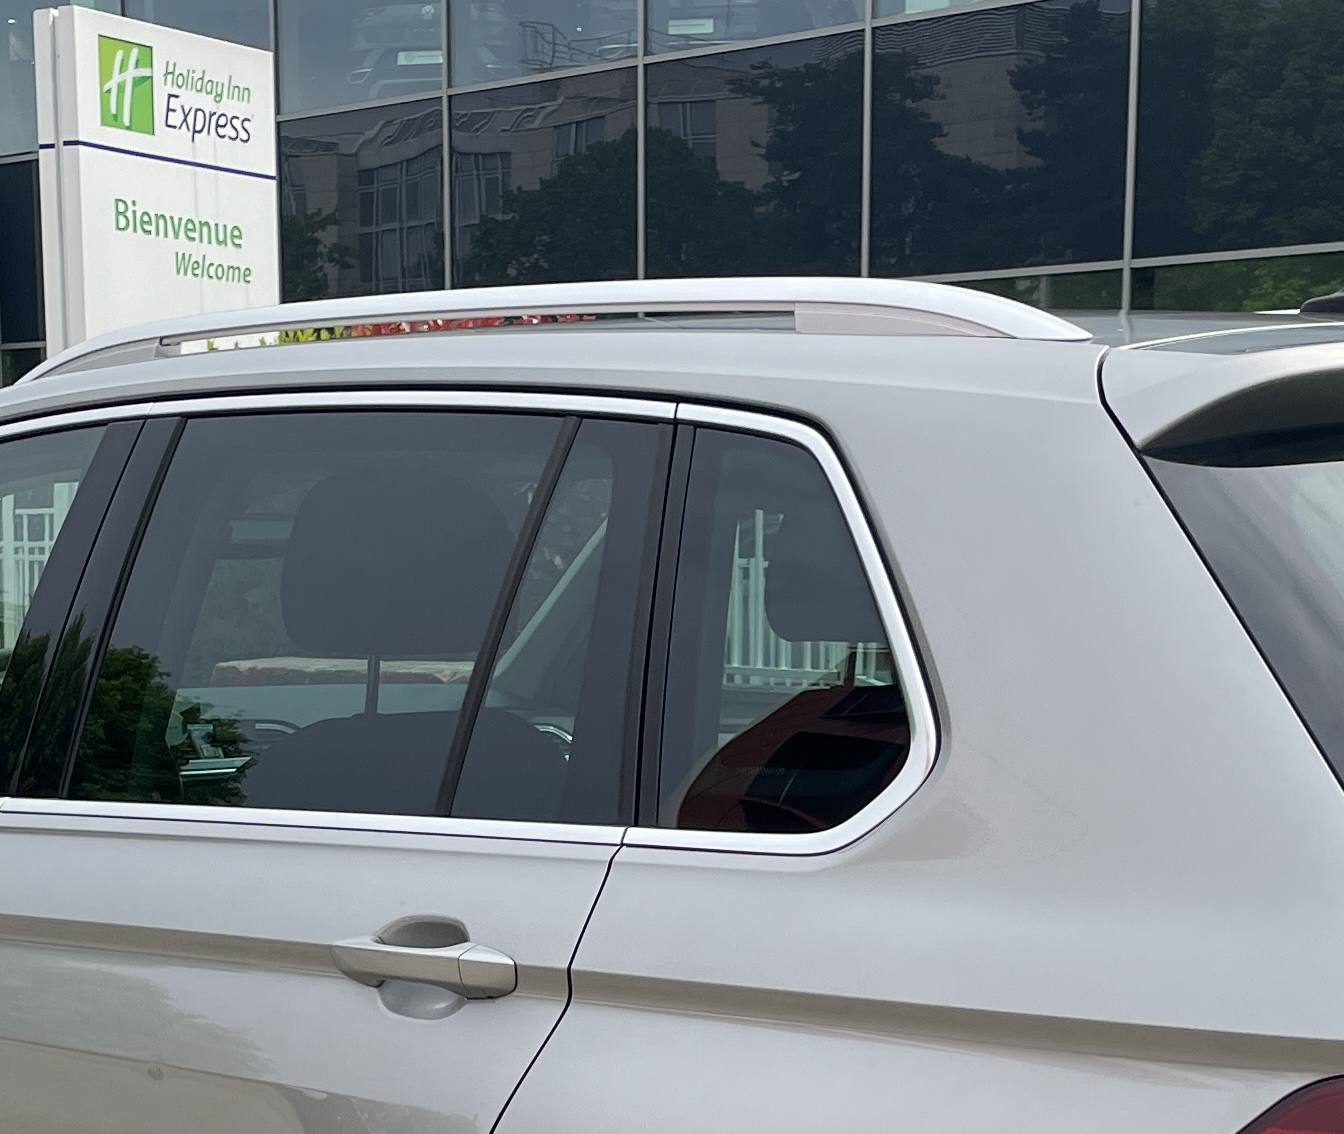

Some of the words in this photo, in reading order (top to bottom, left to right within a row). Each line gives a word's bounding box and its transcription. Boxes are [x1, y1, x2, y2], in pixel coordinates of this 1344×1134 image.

[163, 60, 225, 103] Holiday
[227, 75, 251, 104] Inn
[164, 93, 252, 144] Express
[113, 198, 243, 249] Bienvenue
[175, 251, 253, 284] Welcome
